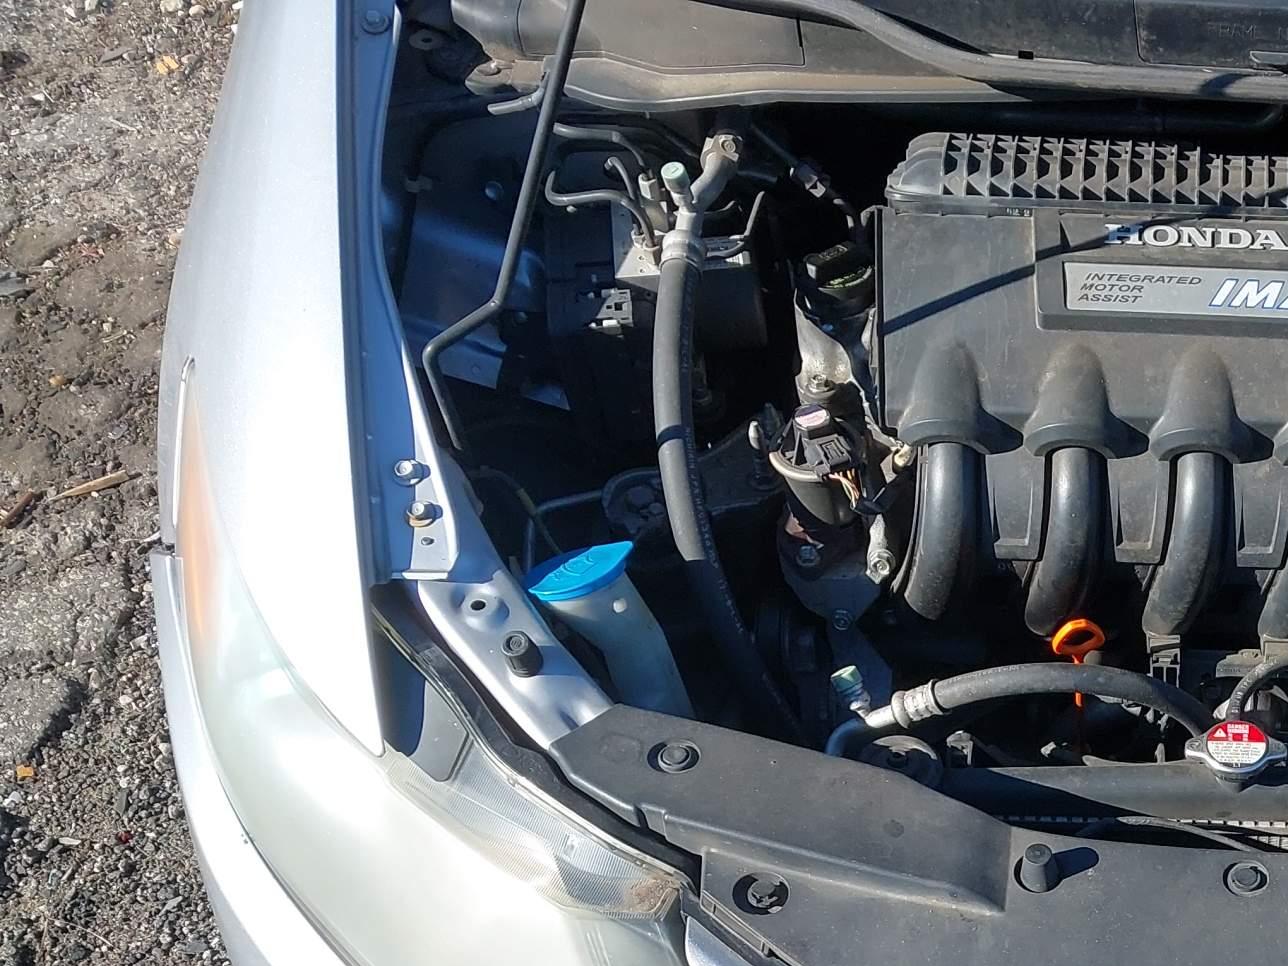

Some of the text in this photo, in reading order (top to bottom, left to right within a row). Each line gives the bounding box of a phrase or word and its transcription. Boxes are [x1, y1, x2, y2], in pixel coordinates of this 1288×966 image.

[1085, 273, 1202, 285] INTEGRATED
[1080, 283, 1145, 293] MOTOR
[1078, 293, 1144, 304] ASSIST
